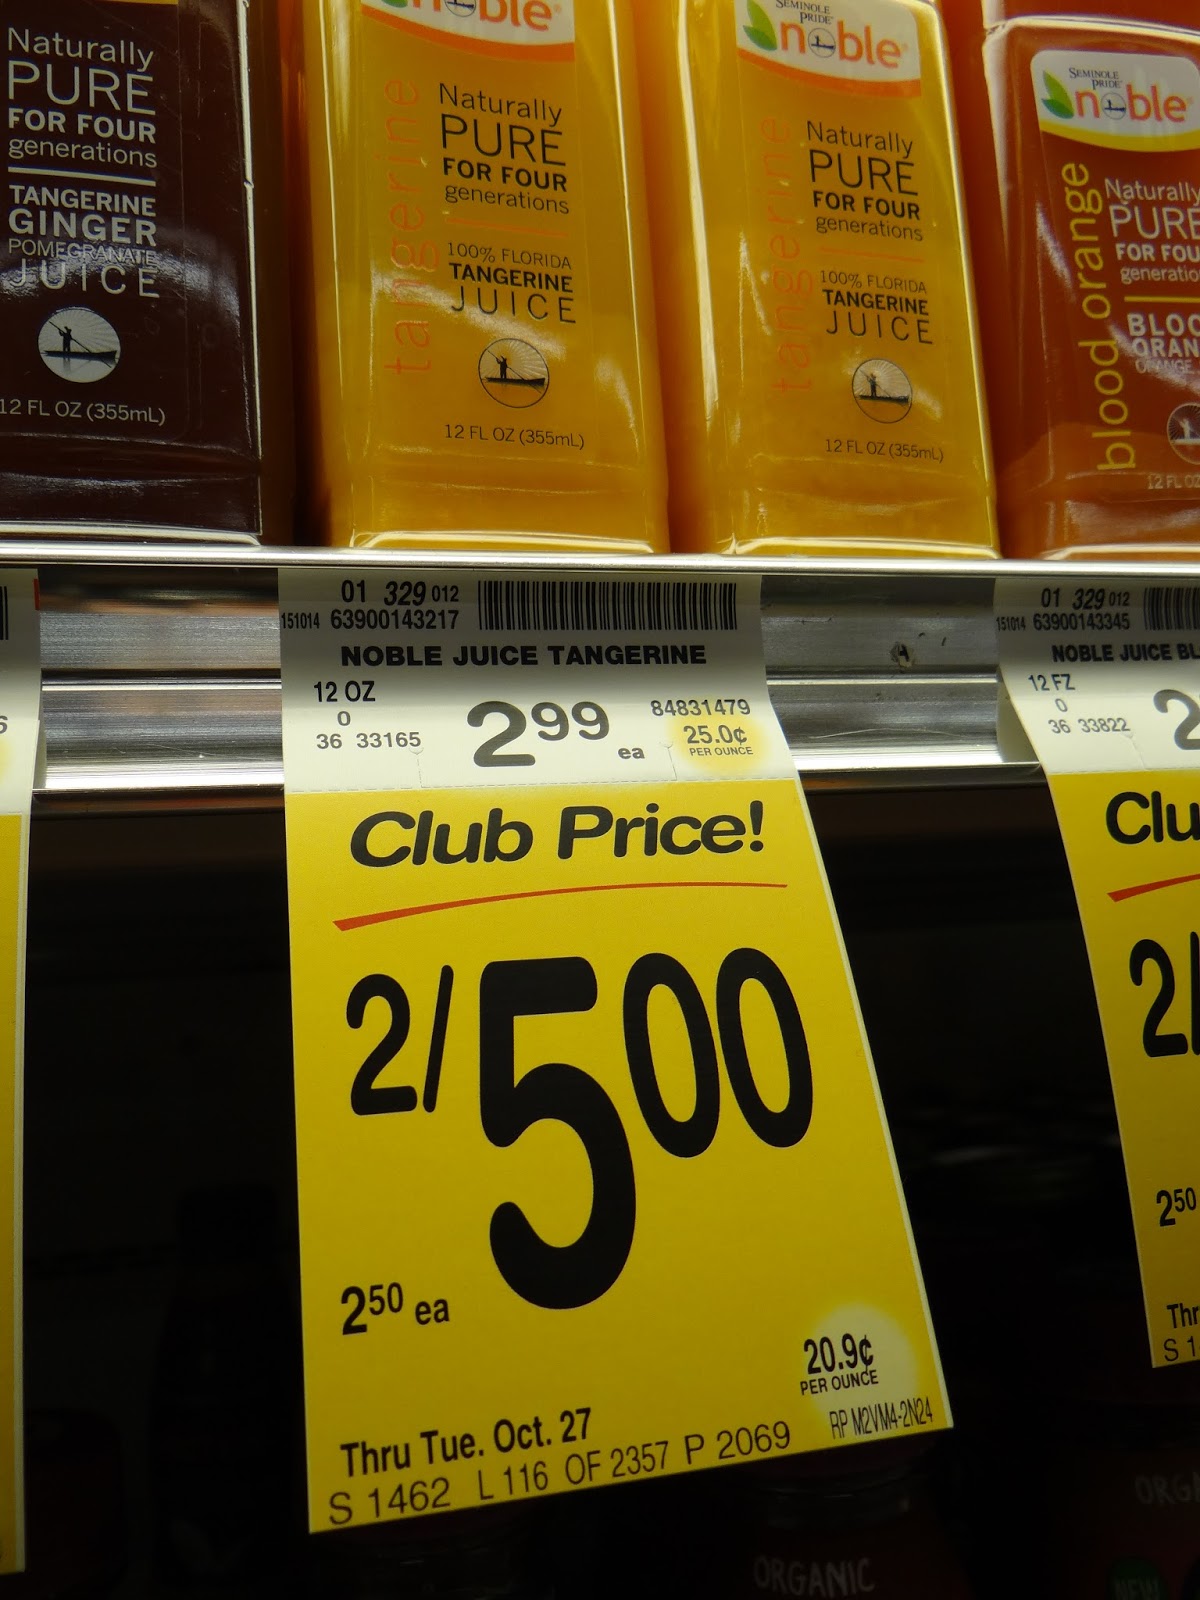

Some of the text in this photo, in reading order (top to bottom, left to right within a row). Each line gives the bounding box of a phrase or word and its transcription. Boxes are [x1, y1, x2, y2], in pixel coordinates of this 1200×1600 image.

[8, 27, 154, 73] Naturally
[1069, 67, 1119, 79] SEMINOLE
[1092, 79, 1121, 90] PRIDE
[8, 60, 156, 116] PURE
[439, 82, 562, 128] Naturally
[8, 107, 156, 144] FOR FOUR
[8, 137, 157, 168] generations
[440, 113, 566, 167] PURE
[807, 120, 913, 159] Naturally
[443, 157, 567, 192] FOR FOUR
[809, 149, 919, 196] PURE
[9, 184, 157, 217] TANGERINE
[445, 184, 569, 215] generations
[812, 190, 921, 220] FOR FOUR
[9, 208, 157, 247] GINGER
[384, 80, 440, 375] tangerine
[816, 215, 923, 241] generations
[1109, 205, 1200, 240] PURE
[8, 238, 156, 264] POMEGRANATE
[448, 242, 572, 270] 100% FLORIDA
[760, 116, 814, 393] tangerine
[1115, 243, 1200, 263] FOR FOU
[10, 258, 160, 299] JUICE
[449, 262, 573, 293] TANGERINE
[820, 270, 928, 294] 100% FLORIDA
[451, 286, 576, 323] JUICE
[822, 289, 929, 316] TANGERINE
[1061, 162, 1136, 470] blood orange
[826, 310, 933, 345] JUICE
[0, 399, 166, 427] 12 FL OZ (355mL)
[445, 424, 585, 450] 12 FL OZ (355mL)
[825, 439, 945, 463] 12 FL OZ (355mL)
[1147, 472, 1163, 490] 12
[1166, 475, 1183, 489] FL
[341, 580, 459, 606] 01 329 012
[1041, 588, 1130, 610] 01 329 012
[281, 609, 460, 630] 151014 63900143217
[996, 613, 1130, 631] 151014 63900143345
[341, 645, 707, 667] NOBLE JUICE TANGERINE
[1051, 645, 1114, 662] NOBLE
[1120, 644, 1172, 661] JUICE
[314, 680, 376, 703] 12 OZ
[1028, 673, 1075, 691] 12 FZ
[337, 710, 351, 727] 0
[650, 698, 751, 717] 84831479
[1055, 698, 1068, 712] 0
[1048, 717, 1131, 734] 36 33822
[316, 731, 422, 749] 36 33165
[617, 747, 645, 760] ea
[689, 746, 754, 757] PER OUNCE
[350, 800, 764, 868] Club Price!
[415, 1299, 450, 1325] ea
[1163, 1338, 1179, 1362] S
[800, 1370, 879, 1396] PER OUNCE
[829, 1396, 933, 1440] RP M2VM4-2N24
[340, 1407, 591, 1478] Thru Tue. Oct. 27
[329, 1420, 791, 1526] S 1462 L 116 OF 2357 P 2069
[752, 1554, 876, 1599] ORGANIC
